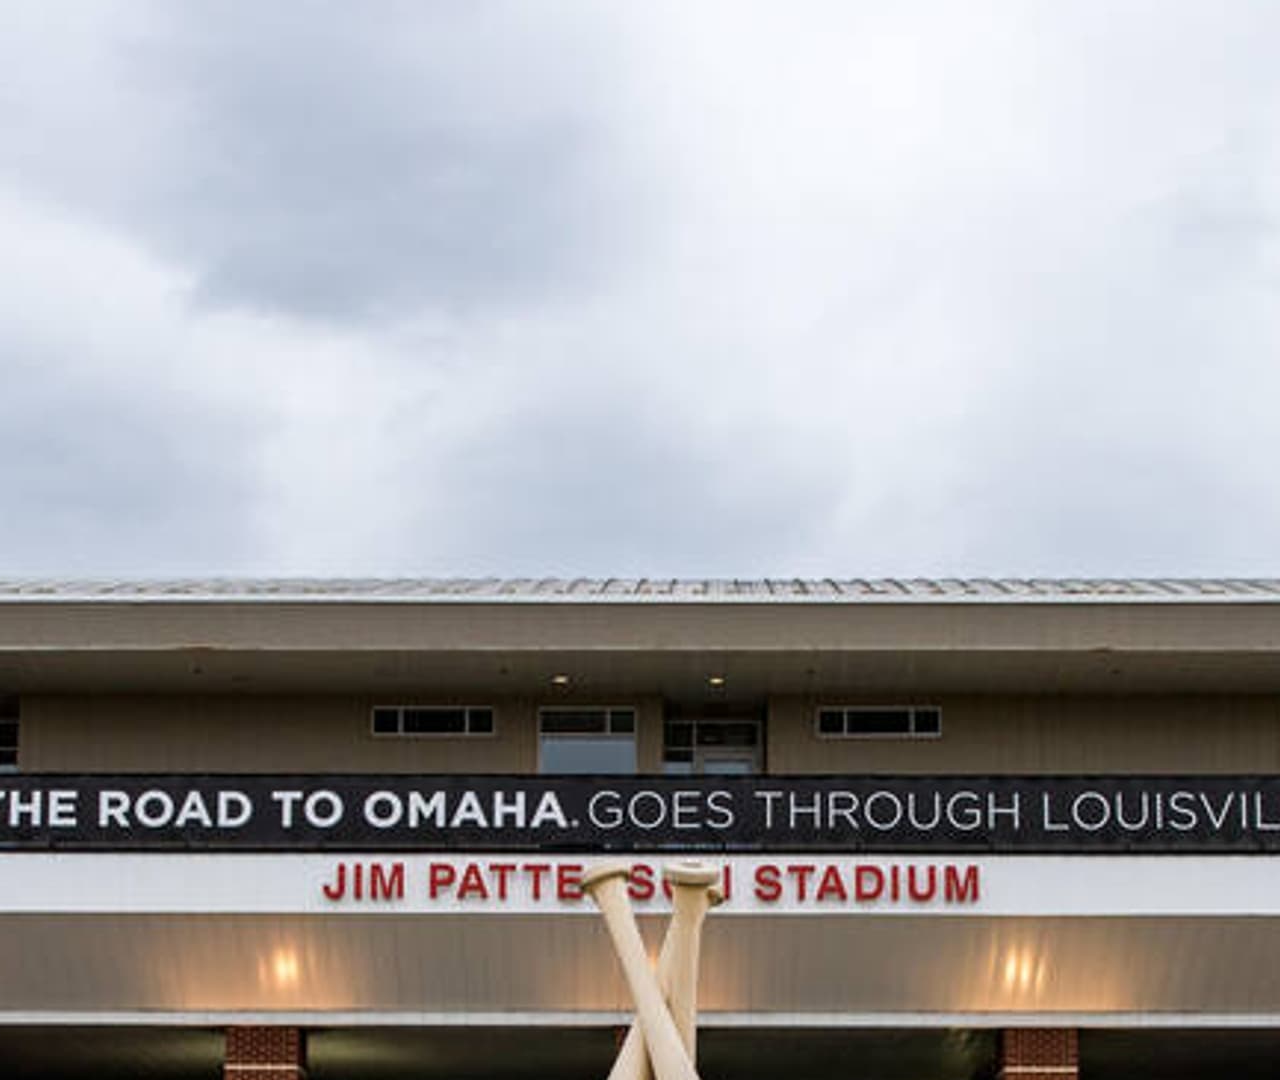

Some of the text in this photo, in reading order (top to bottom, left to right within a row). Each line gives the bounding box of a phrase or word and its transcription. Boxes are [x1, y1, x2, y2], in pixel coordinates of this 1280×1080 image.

[98, 790, 253, 828] ROAD
[272, 790, 345, 828] TO
[588, 791, 734, 829] GOES
[754, 791, 1020, 830] THROUGH
[322, 864, 404, 899] JIM
[756, 865, 979, 900] STADIUM
